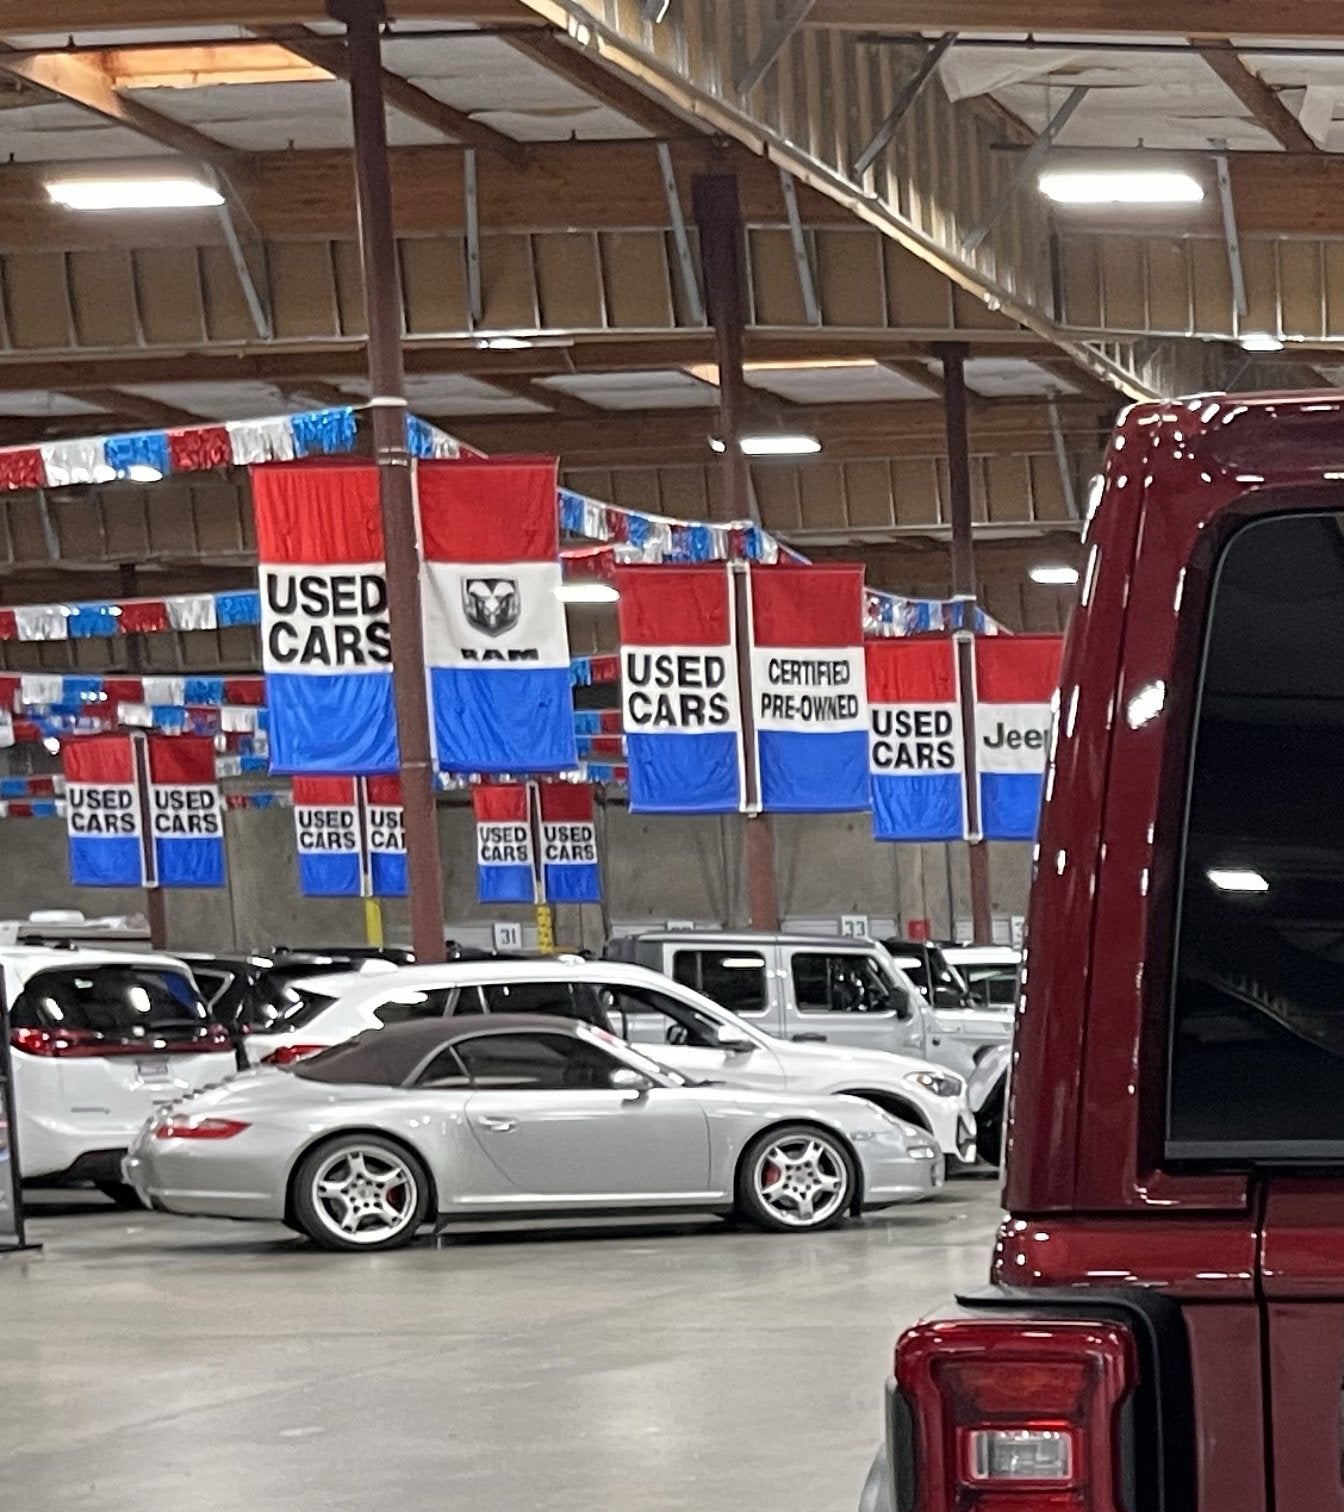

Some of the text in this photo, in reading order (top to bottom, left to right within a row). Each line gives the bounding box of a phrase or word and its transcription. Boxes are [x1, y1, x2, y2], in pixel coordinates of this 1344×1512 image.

[266, 573, 389, 618] USED
[268, 621, 393, 666] CARS
[627, 653, 726, 689] USED
[767, 657, 851, 686] CERTIFIED
[628, 691, 731, 727] CARS
[761, 692, 859, 722] PRE-OWNED
[872, 709, 954, 738] USED
[872, 740, 956, 769] CARS
[69, 788, 133, 810] USED
[154, 789, 216, 811] USED
[71, 811, 137, 833] CARS
[155, 812, 219, 834] CARS
[298, 809, 355, 829] USED
[300, 831, 356, 849] CARS
[371, 830, 406, 849] CA
[479, 825, 528, 844] USED
[543, 825, 593, 843] USED
[481, 844, 529, 862] CARS
[545, 844, 595, 861] CARS
